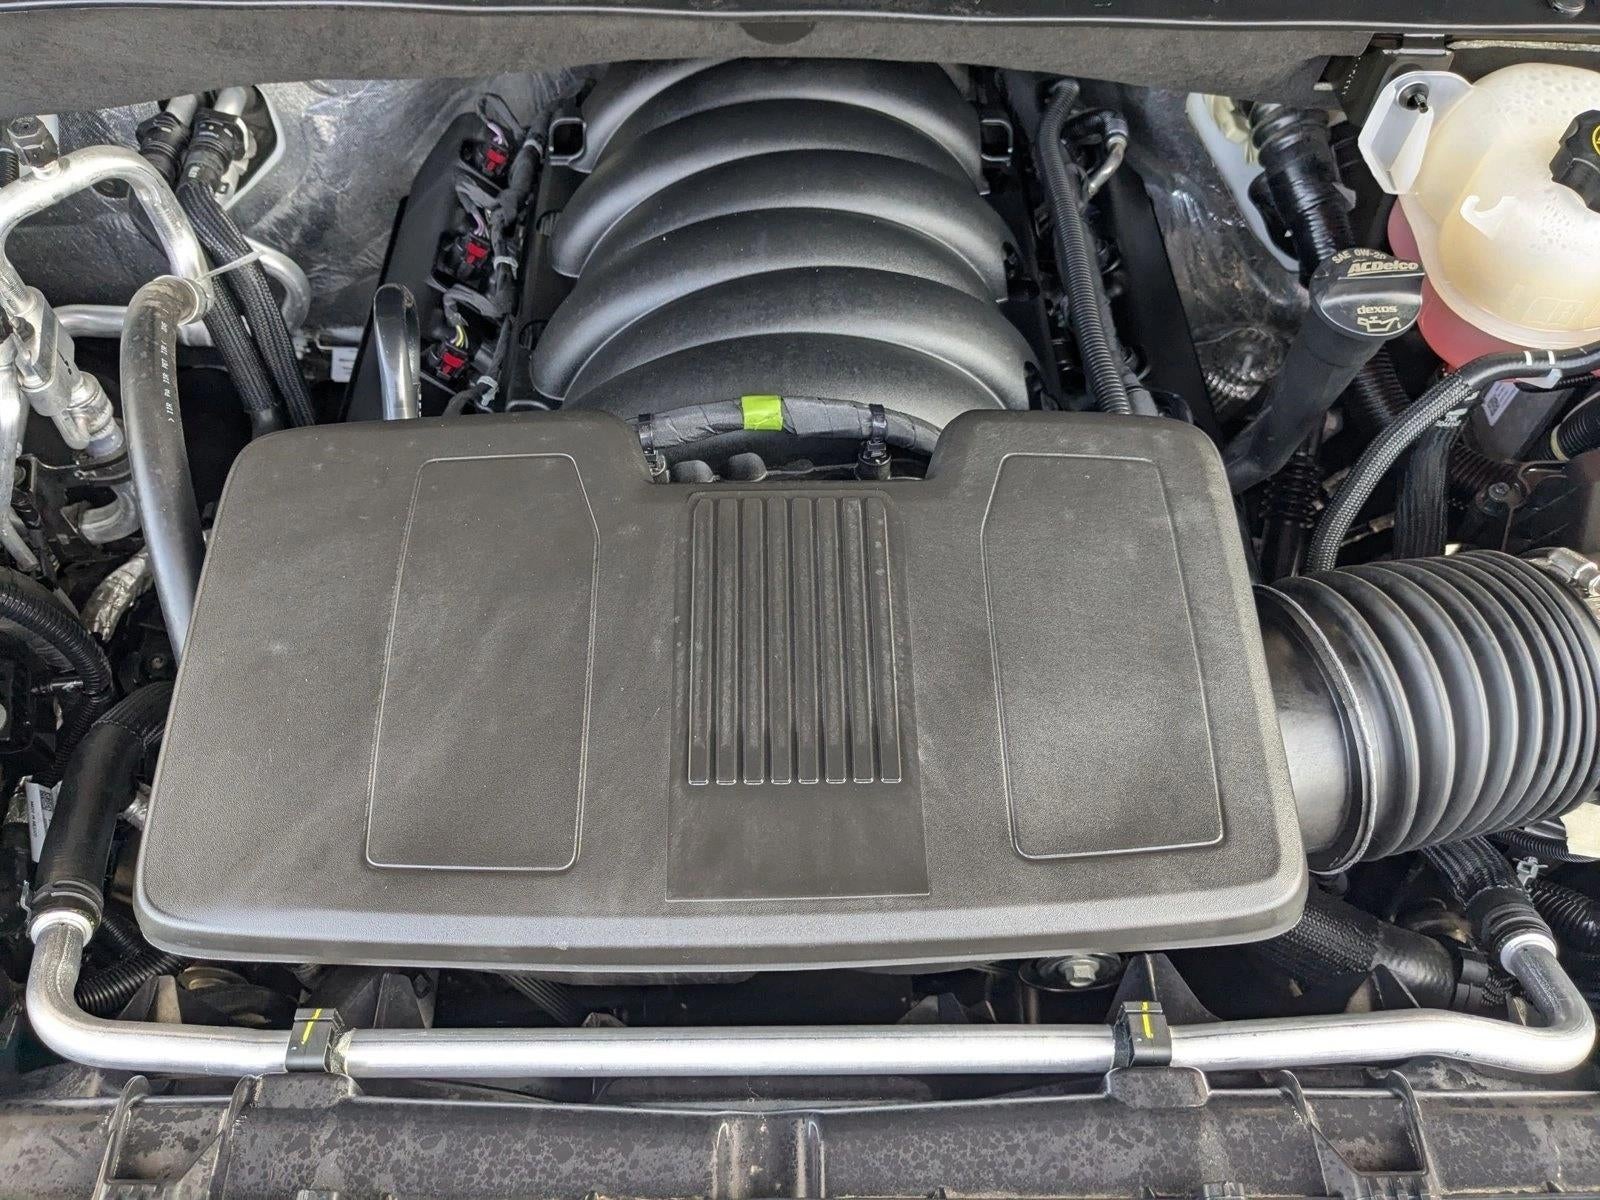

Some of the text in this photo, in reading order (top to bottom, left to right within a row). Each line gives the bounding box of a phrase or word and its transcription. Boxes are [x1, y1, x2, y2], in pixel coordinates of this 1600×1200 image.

[1332, 250, 1352, 264] SAE
[1347, 260, 1419, 274] ACDelco
[1357, 305, 1398, 315] dexos
